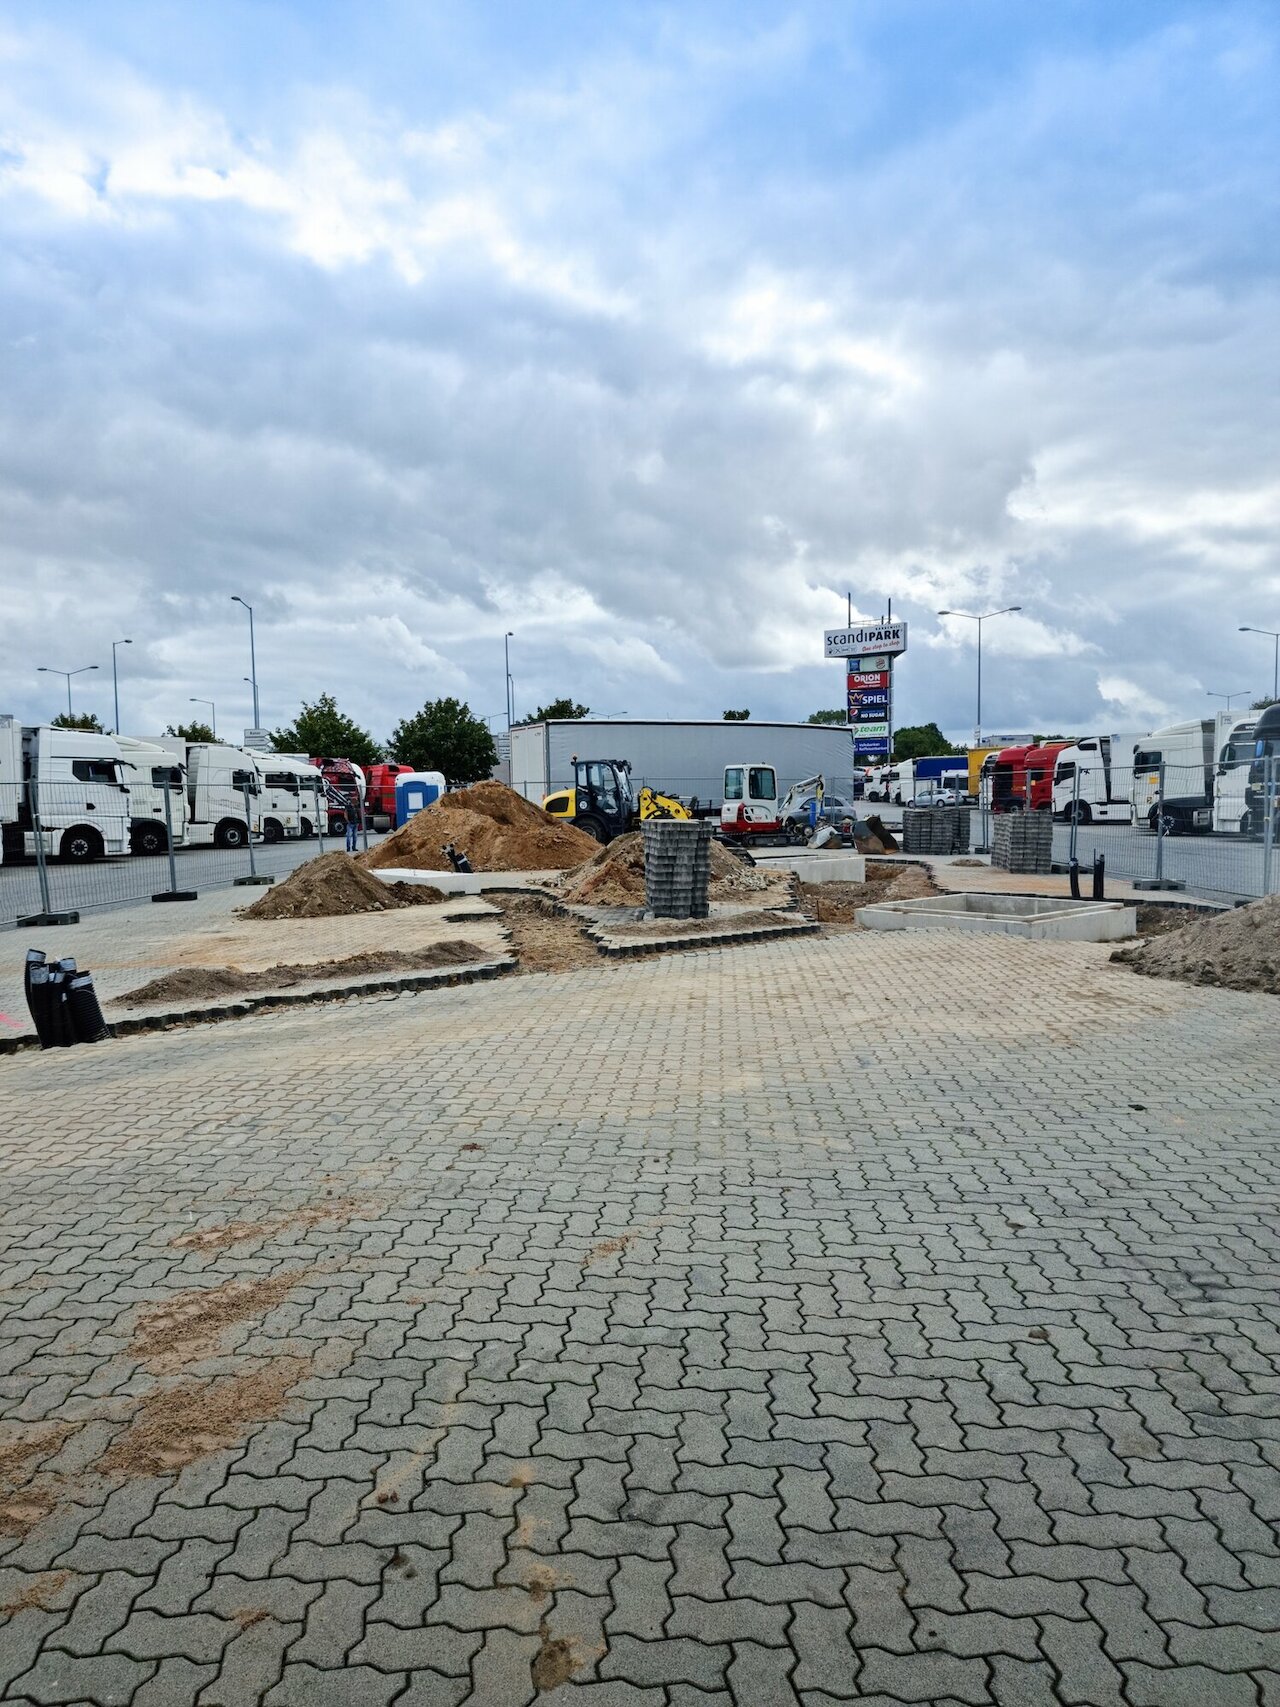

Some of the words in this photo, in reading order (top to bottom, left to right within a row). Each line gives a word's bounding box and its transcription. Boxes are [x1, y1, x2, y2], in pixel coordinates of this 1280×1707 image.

[853, 673, 881, 683] ORION
[862, 695, 888, 704] SPIEL
[860, 725, 886, 733] team
